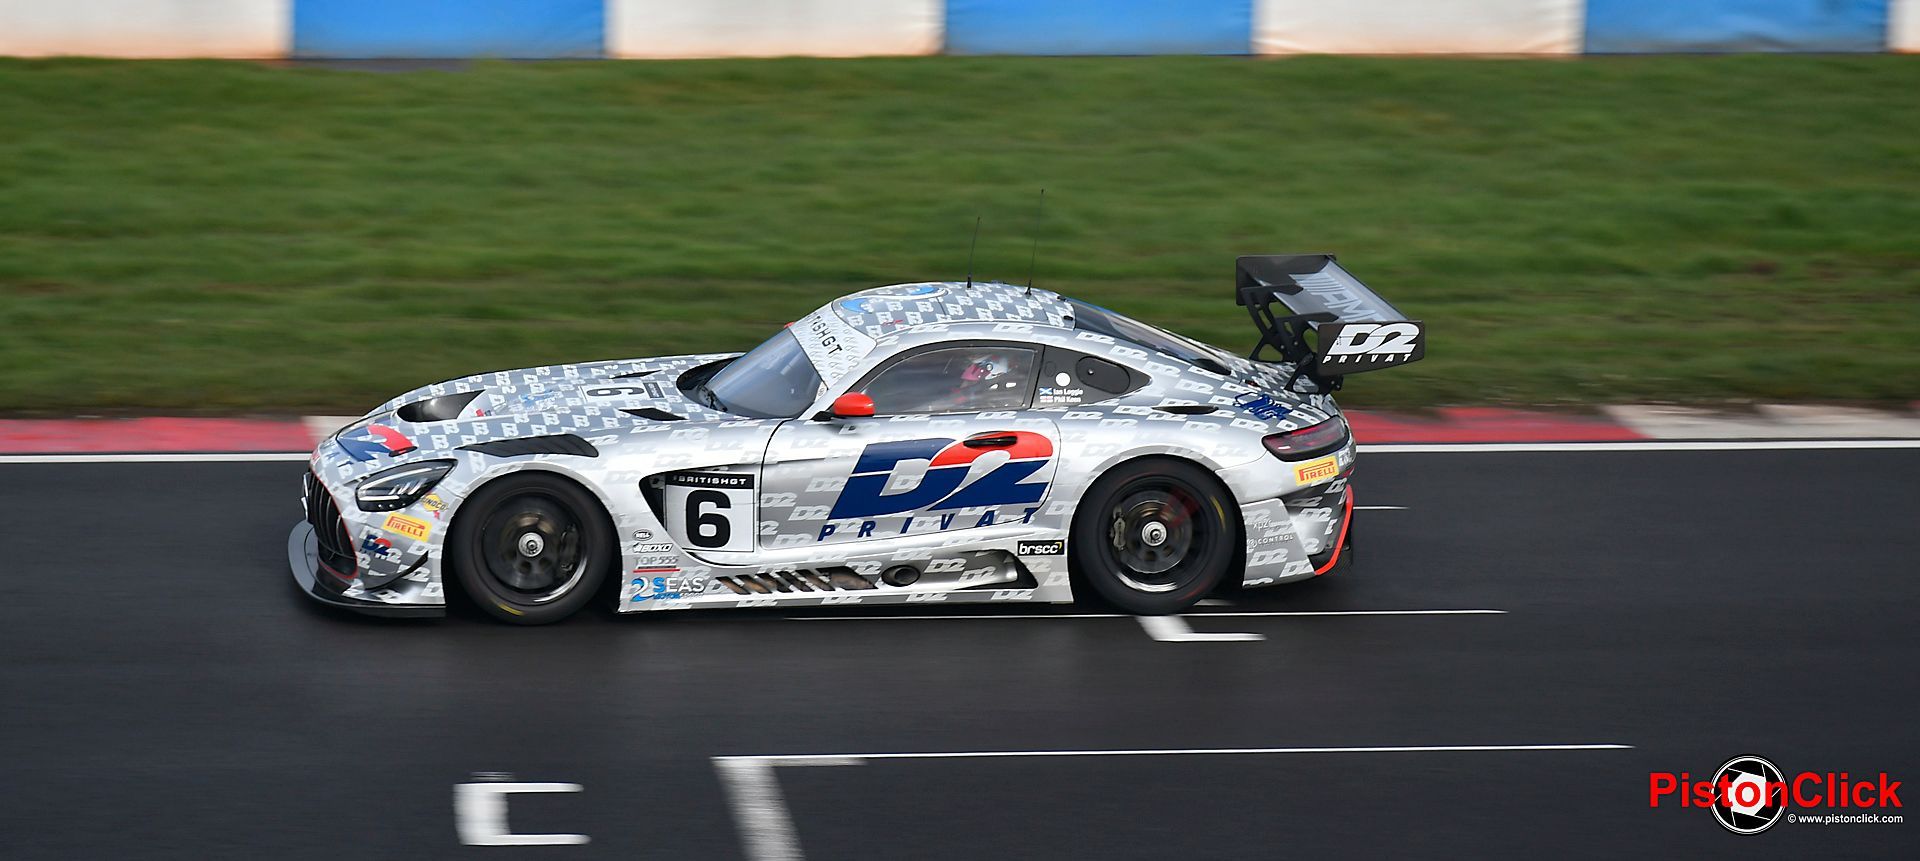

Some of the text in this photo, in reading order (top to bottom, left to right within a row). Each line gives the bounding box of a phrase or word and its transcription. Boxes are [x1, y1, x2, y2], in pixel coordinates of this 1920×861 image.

[992, 322, 1034, 334] D2
[1076, 331, 1115, 345] D2
[1326, 322, 1420, 356] D2
[1109, 345, 1148, 361] D2
[1322, 353, 1412, 364] PRIVAT
[975, 411, 1018, 420] D2
[1063, 411, 1104, 420] D2
[827, 431, 1053, 519] D2
[1299, 461, 1336, 482] PIRELLI
[677, 476, 747, 486] BRITISHGT
[761, 493, 797, 508] D2
[686, 489, 731, 548] 6
[788, 505, 832, 520] D2
[1299, 507, 1332, 522] D2
[386, 516, 426, 537] PIRELLI
[817, 507, 1036, 542] PRIVAT
[362, 534, 393, 556] D2
[1258, 533, 1295, 545] CONTROL
[1018, 542, 1059, 555] brscc
[1248, 548, 1289, 567] D2
[924, 558, 967, 573] D2
[652, 577, 705, 593] SEAS
